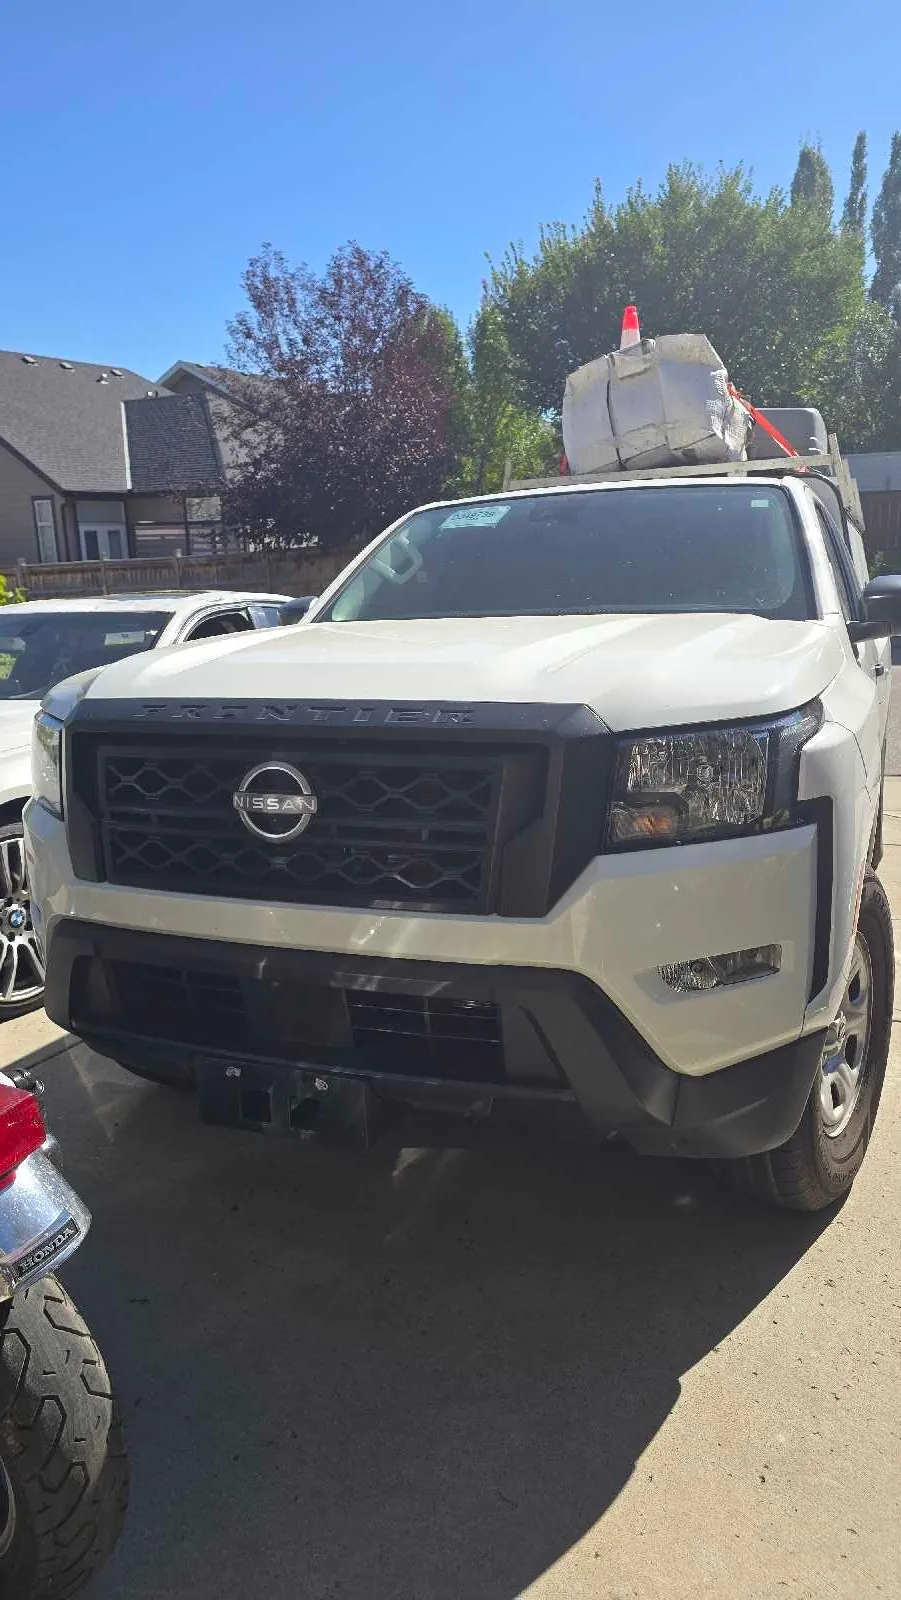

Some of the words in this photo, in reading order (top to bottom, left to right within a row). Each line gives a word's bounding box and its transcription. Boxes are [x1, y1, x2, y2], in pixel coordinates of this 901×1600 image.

[133, 703, 477, 724] FRONTIER
[234, 795, 316, 811] NISSAN
[19, 1226, 75, 1273] HONDA
